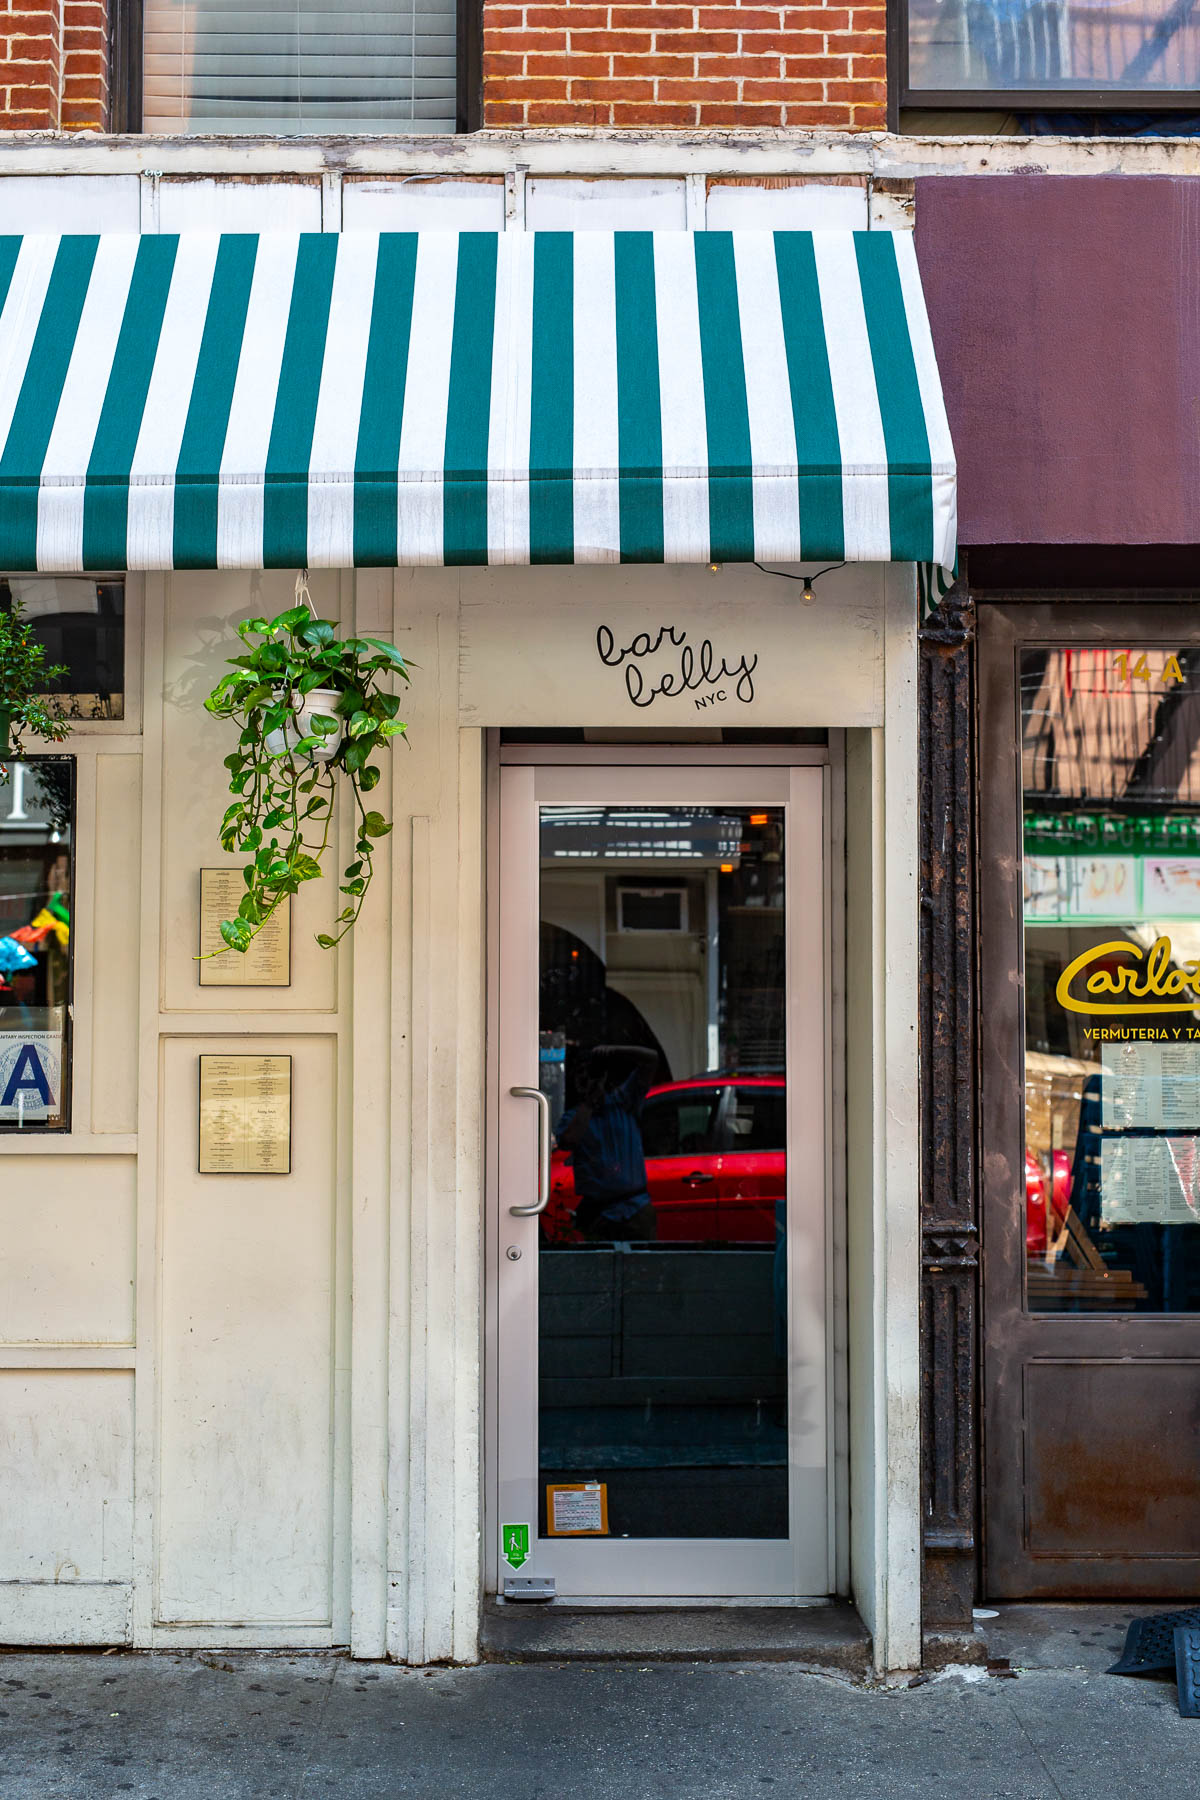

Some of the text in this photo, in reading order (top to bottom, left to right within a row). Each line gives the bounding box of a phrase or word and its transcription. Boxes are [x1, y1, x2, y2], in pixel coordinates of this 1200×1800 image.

[597, 625, 686, 667] bar
[625, 640, 758, 707] belly
[1113, 653, 1185, 683] 14 A
[694, 689, 728, 711] NYC
[1083, 1028, 1168, 1040] VERMUTERIA
[1172, 1028, 1181, 1039] Y
[0, 1044, 56, 1105] A
